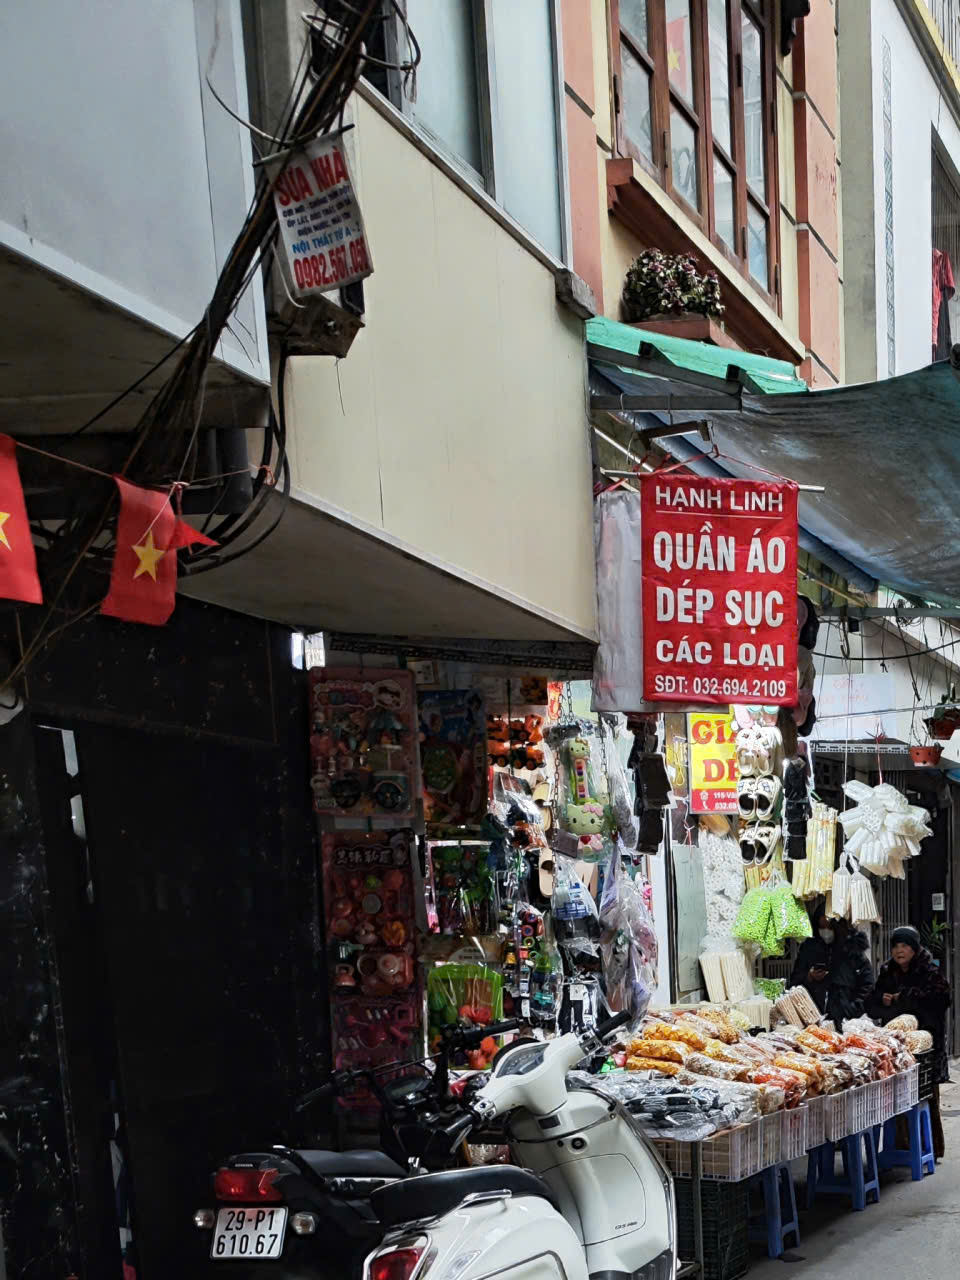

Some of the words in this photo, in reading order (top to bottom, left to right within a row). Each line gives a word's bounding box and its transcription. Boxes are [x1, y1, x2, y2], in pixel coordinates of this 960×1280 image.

[655, 485, 721, 512] HẠNH
[730, 490, 783, 513] LINH
[653, 521, 736, 573] QUẦN
[746, 528, 786, 574] ÁO
[656, 579, 714, 624] DÉP
[725, 589, 784, 634] SỤC
[656, 635, 712, 665] CÁC
[724, 643, 784, 671] LOẠI
[655, 675, 688, 694] SĐT:
[693, 677, 786, 697] 032.694.2109
[224, 1210, 275, 1231] 29-P1
[216, 1233, 278, 1255] 610.67
